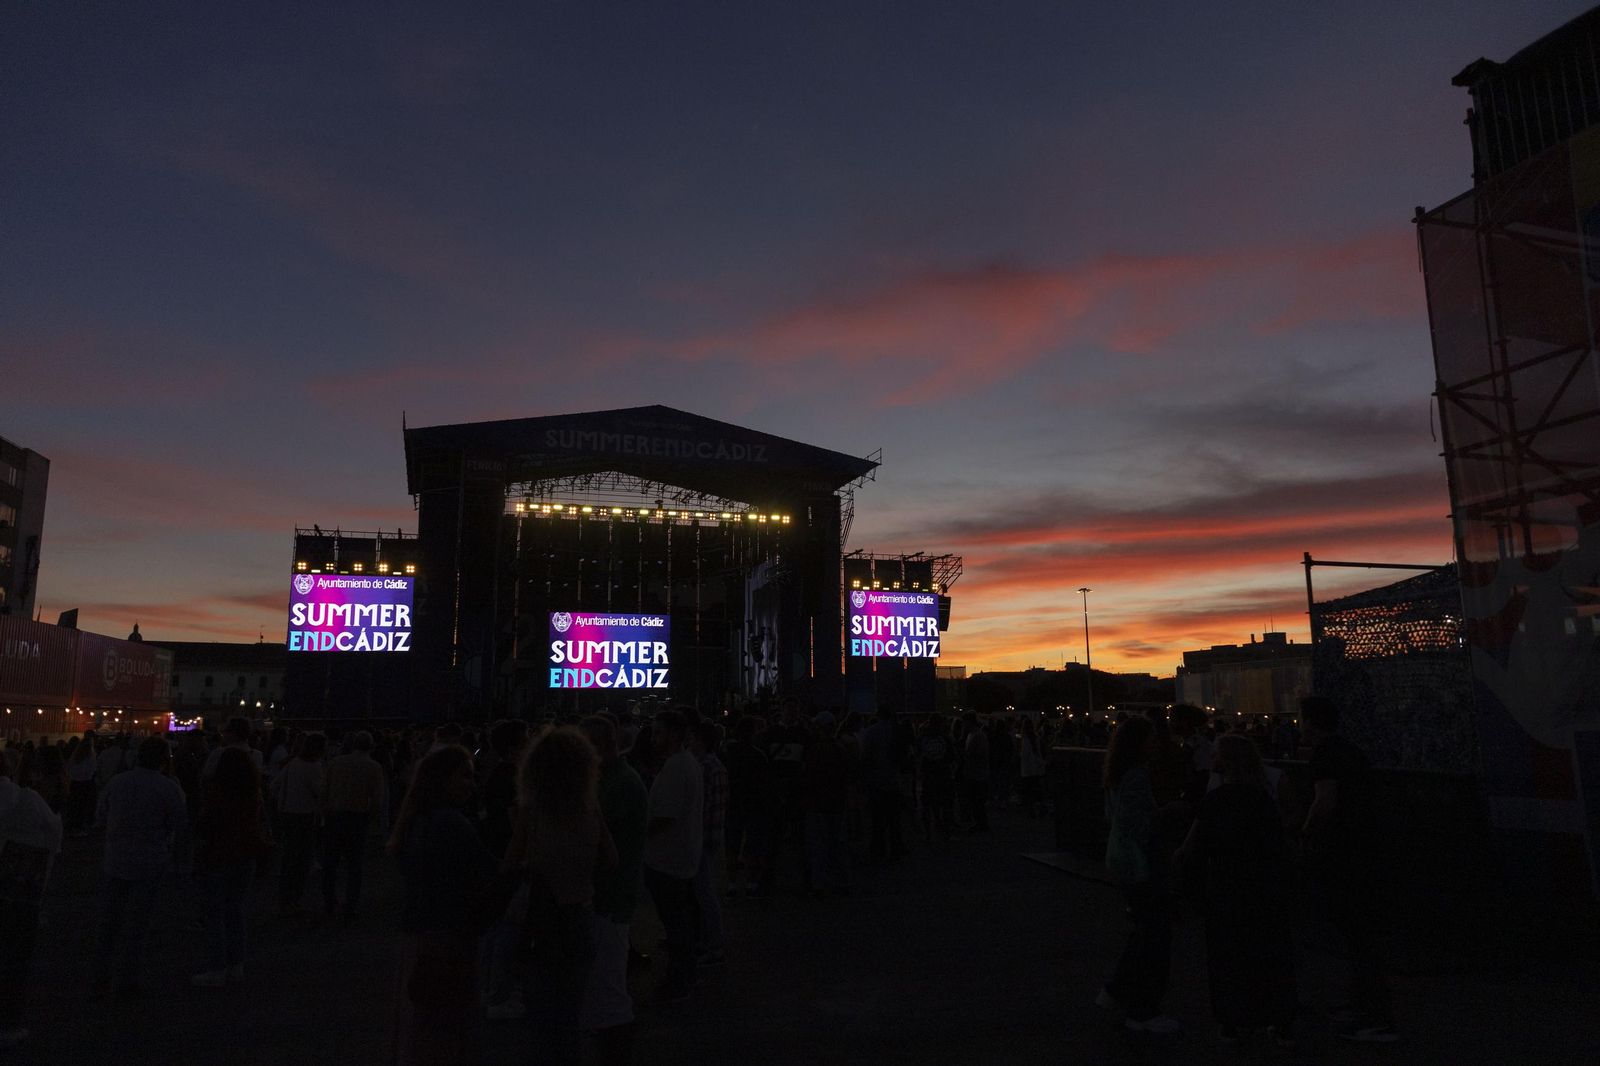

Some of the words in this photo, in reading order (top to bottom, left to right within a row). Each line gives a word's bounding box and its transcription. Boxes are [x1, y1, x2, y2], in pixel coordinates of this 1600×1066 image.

[317, 577, 371, 590] Ayuntamiento
[372, 579, 383, 588] de
[384, 579, 408, 590] Cádiz
[868, 594, 908, 604] Ayuntamiento
[908, 596, 916, 604] de
[916, 595, 934, 605] Cádiz
[290, 602, 411, 627] SUMMER
[575, 615, 629, 627] Ayuntamiento
[629, 617, 640, 626] de
[641, 617, 664, 627] Cádiz
[851, 615, 939, 637] SUMMER
[288, 627, 411, 652] ENDCÁDIZ
[851, 637, 940, 658] ENDCÁDIZ
[550, 640, 670, 664] SUMMER
[549, 664, 669, 688] ENDCÁDIZ
